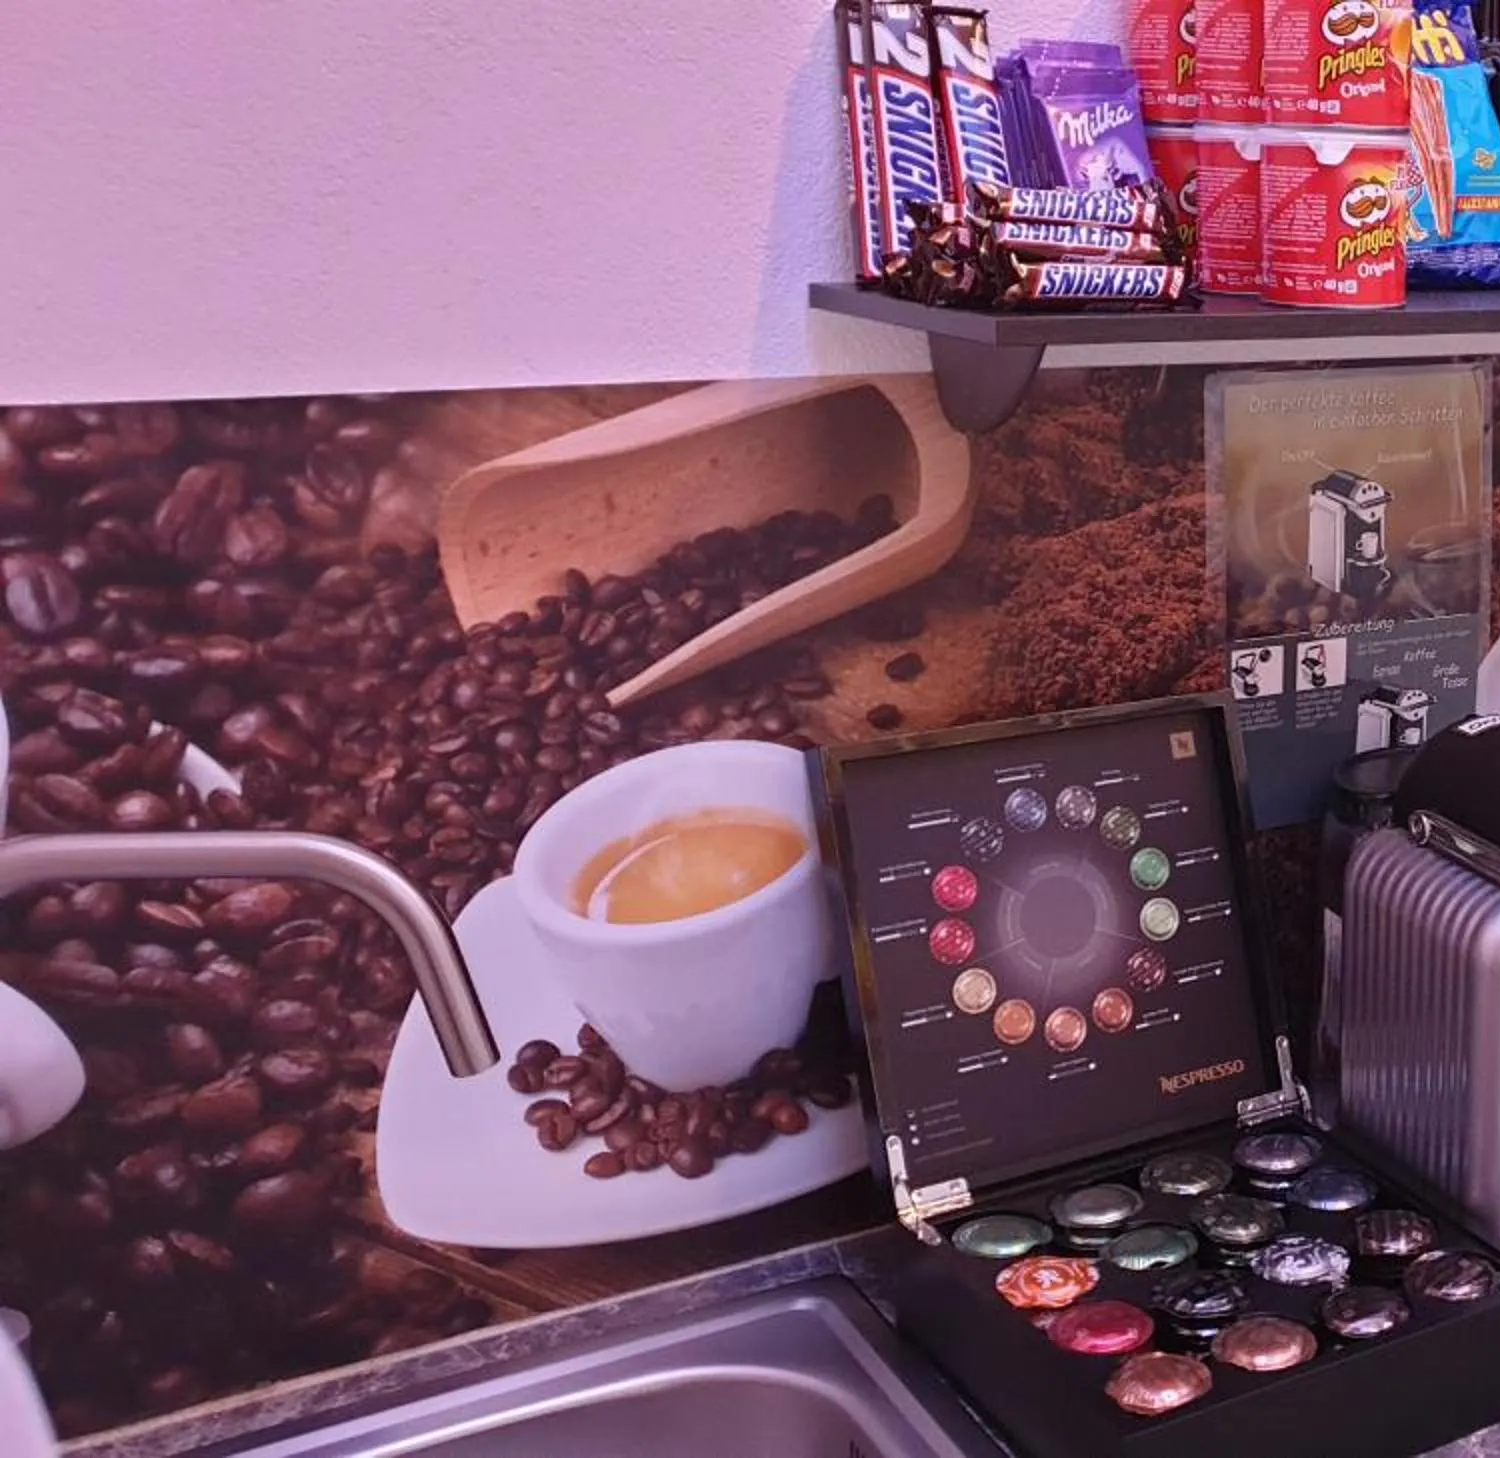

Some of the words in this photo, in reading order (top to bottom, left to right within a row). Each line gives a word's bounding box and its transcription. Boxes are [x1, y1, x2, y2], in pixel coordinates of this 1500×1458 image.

[1317, 45, 1387, 89] Pringles
[1058, 102, 1134, 148] Milka
[1012, 187, 1136, 224] SNICKERS
[1337, 222, 1397, 270] Pringles
[1040, 265, 1164, 298] SNICKERS
[1314, 618, 1397, 638] Zubereitung
[1159, 1058, 1245, 1094] NESPRESSO
